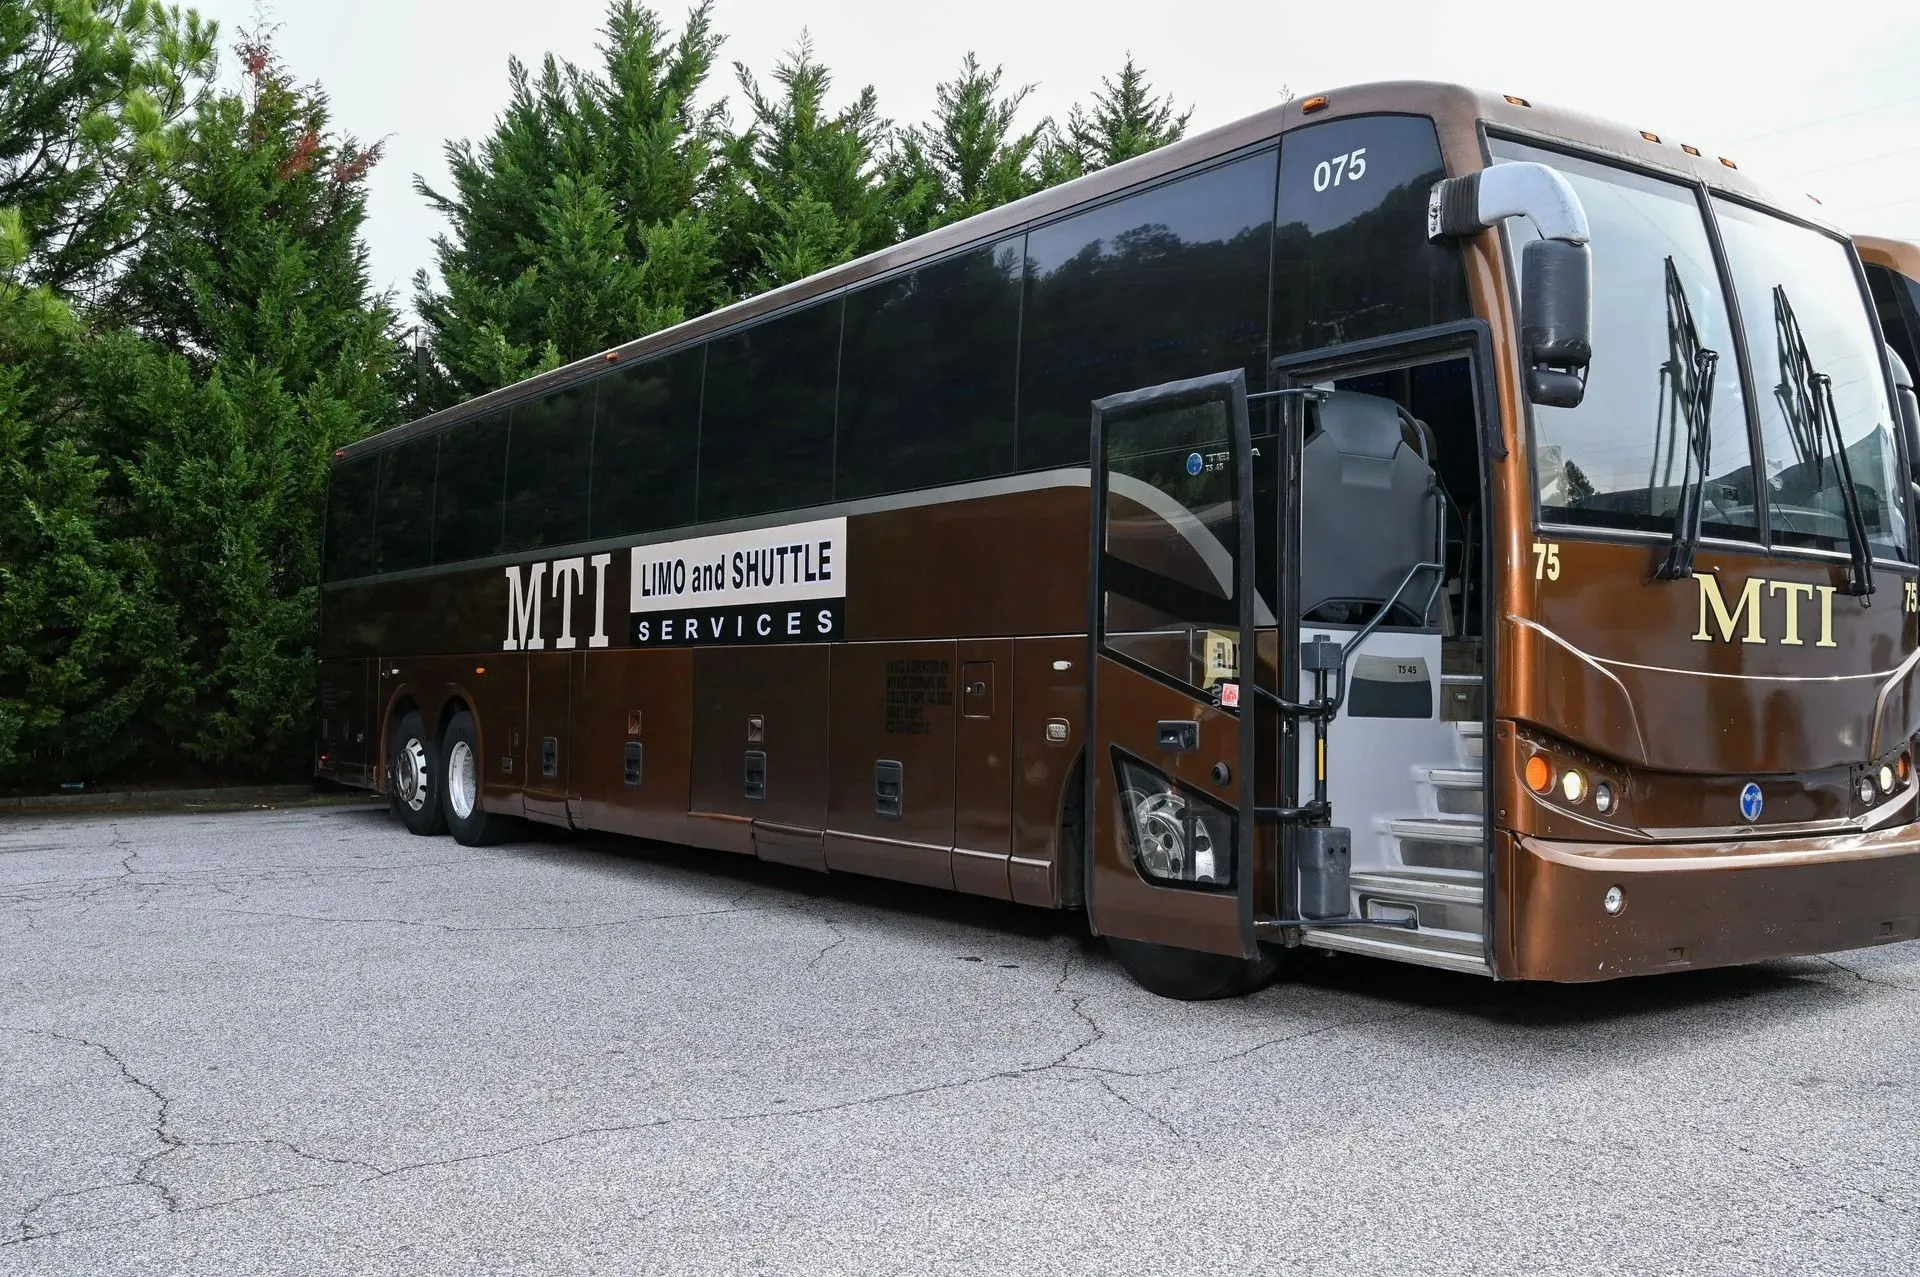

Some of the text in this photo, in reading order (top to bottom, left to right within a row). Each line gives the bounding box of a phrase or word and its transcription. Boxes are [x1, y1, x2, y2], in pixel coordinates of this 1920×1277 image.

[1313, 147, 1367, 192] 075
[641, 540, 832, 597] LIMO and SHUTTLE
[1532, 543, 1560, 581] 75
[503, 553, 611, 650] MTI
[1691, 572, 1838, 647] MTI
[1905, 582, 1917, 613] 75
[638, 609, 833, 642] SERVICES
[1397, 665, 1417, 674] TS 45
